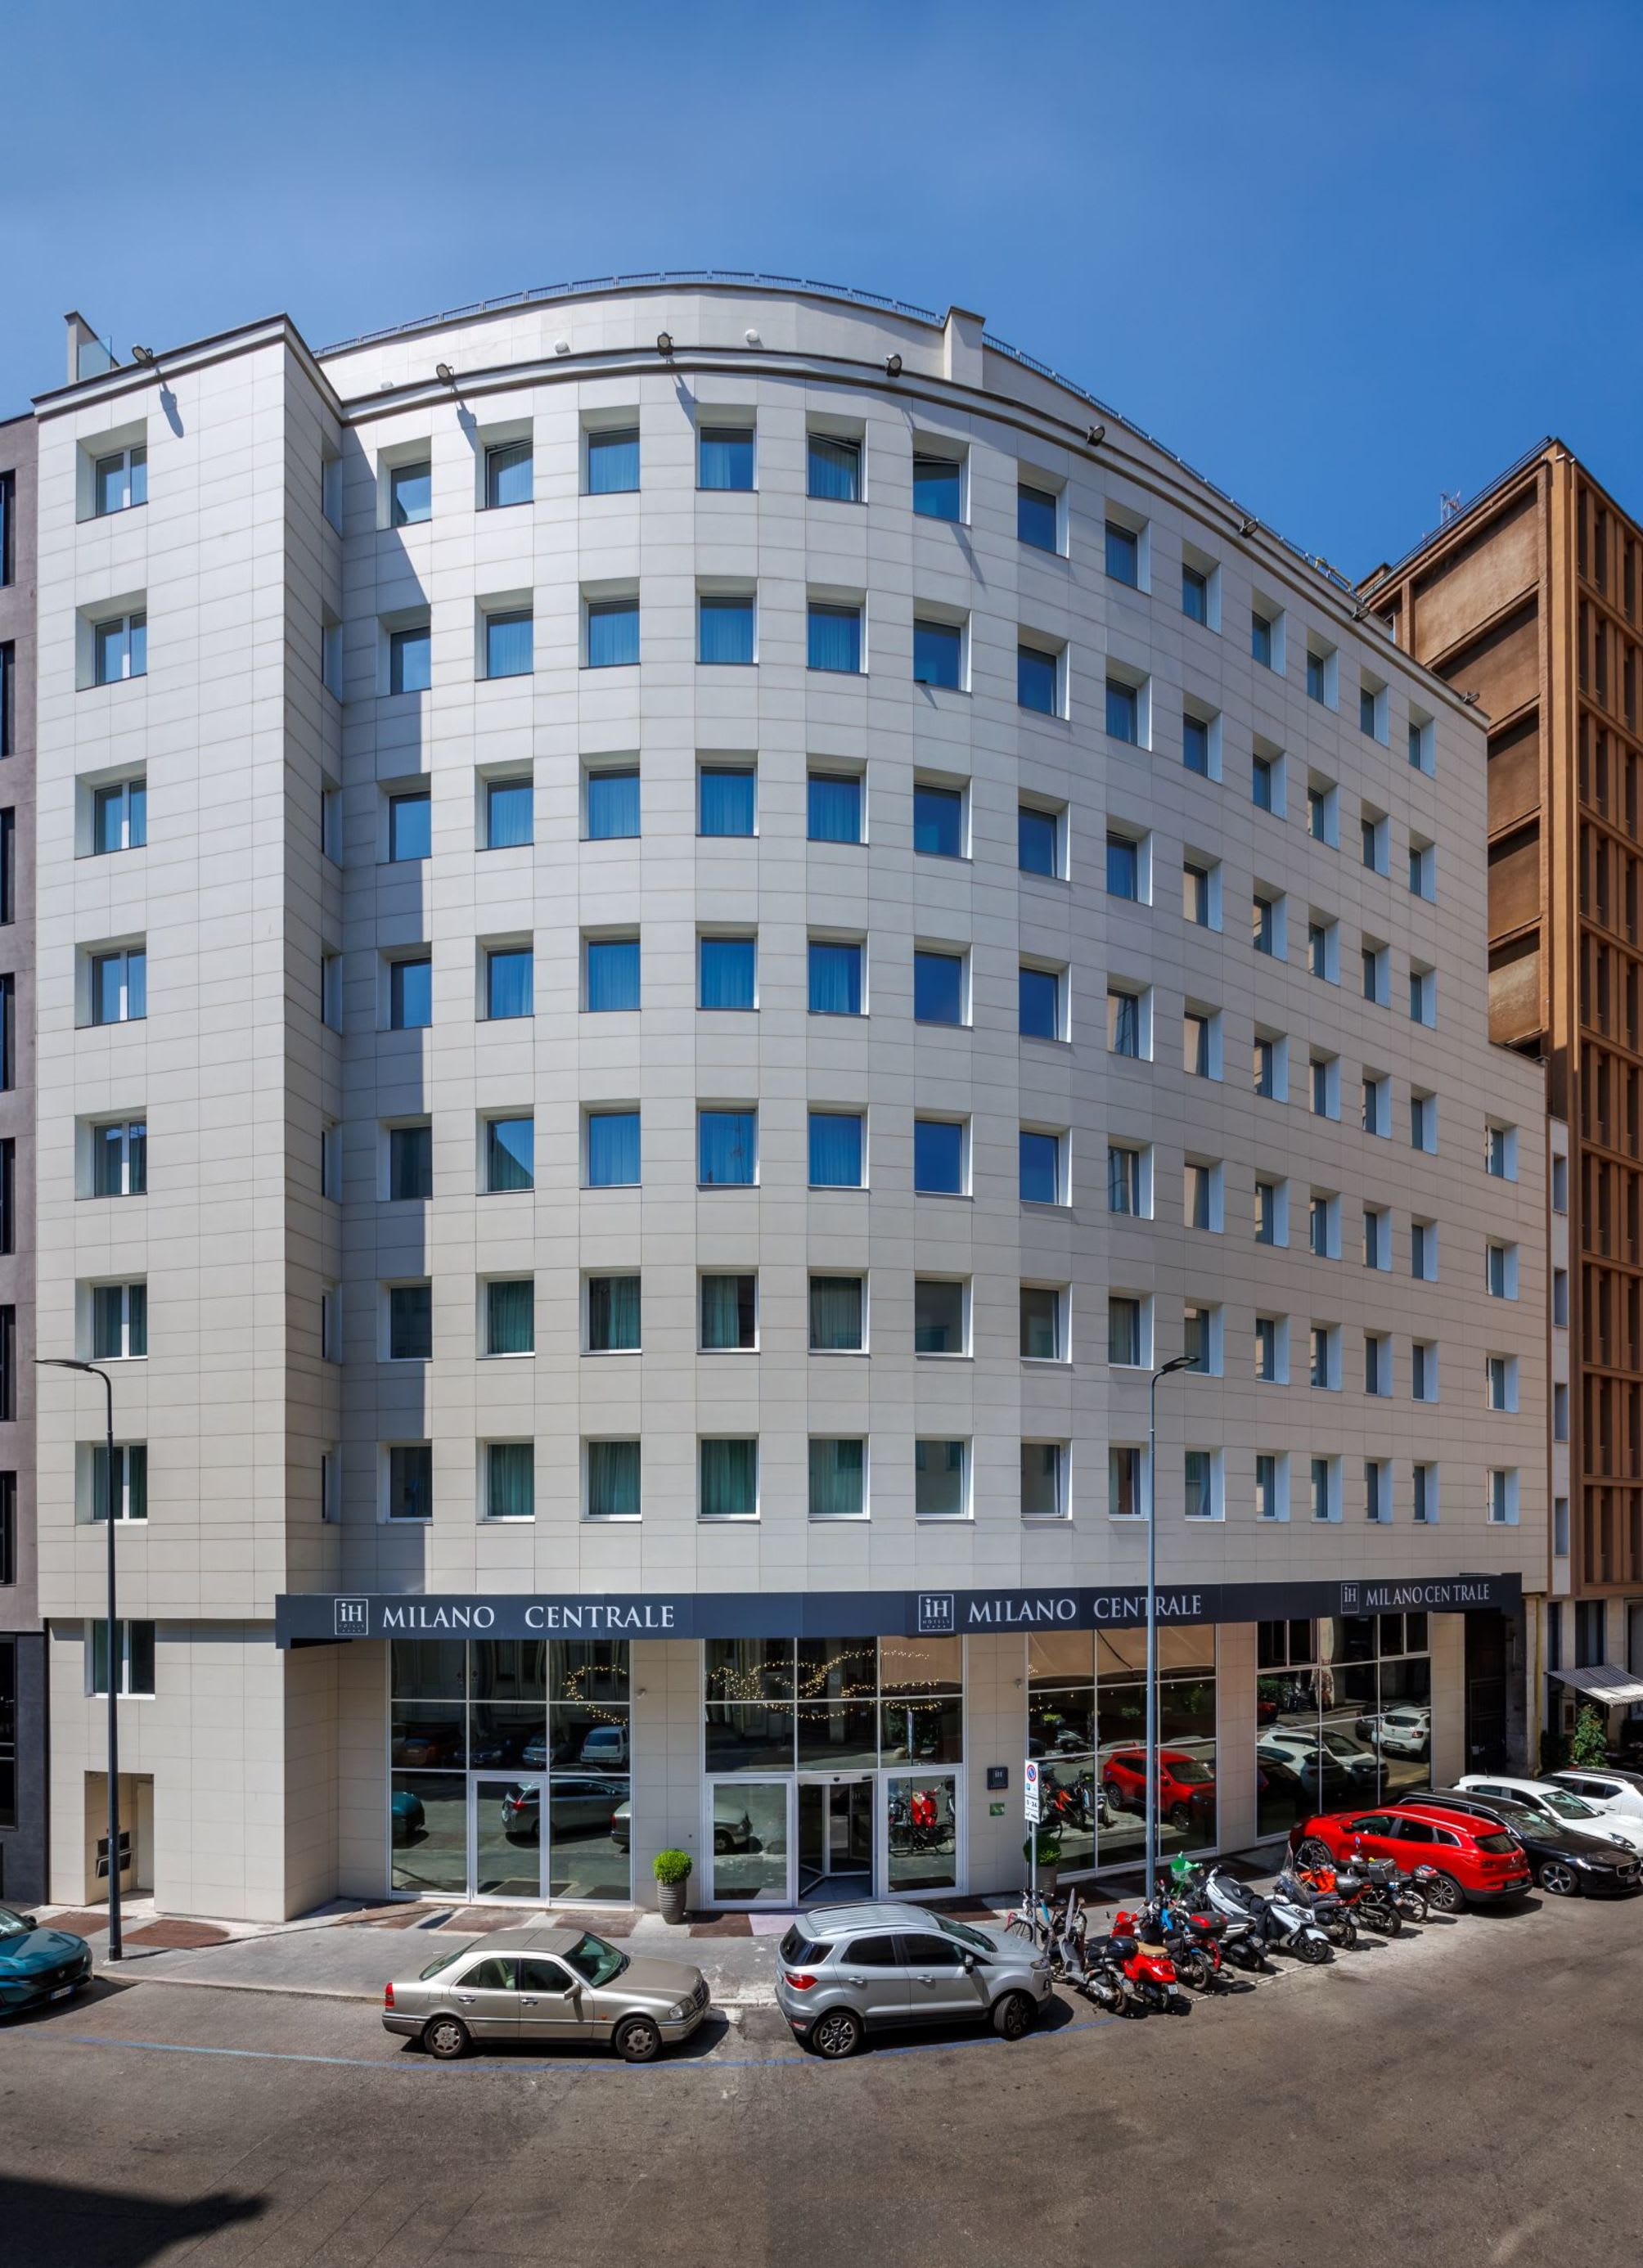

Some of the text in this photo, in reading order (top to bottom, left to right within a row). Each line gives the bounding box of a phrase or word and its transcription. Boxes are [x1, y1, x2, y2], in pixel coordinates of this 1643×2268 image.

[1344, 1586, 1357, 1603] iH
[1366, 1583, 1489, 1606] MILANO CENTRALE
[340, 1602, 362, 1622] iH
[383, 1605, 674, 1628] MILANO CENTRALE
[924, 1598, 949, 1618] iH
[968, 1599, 1076, 1622] MILANO
